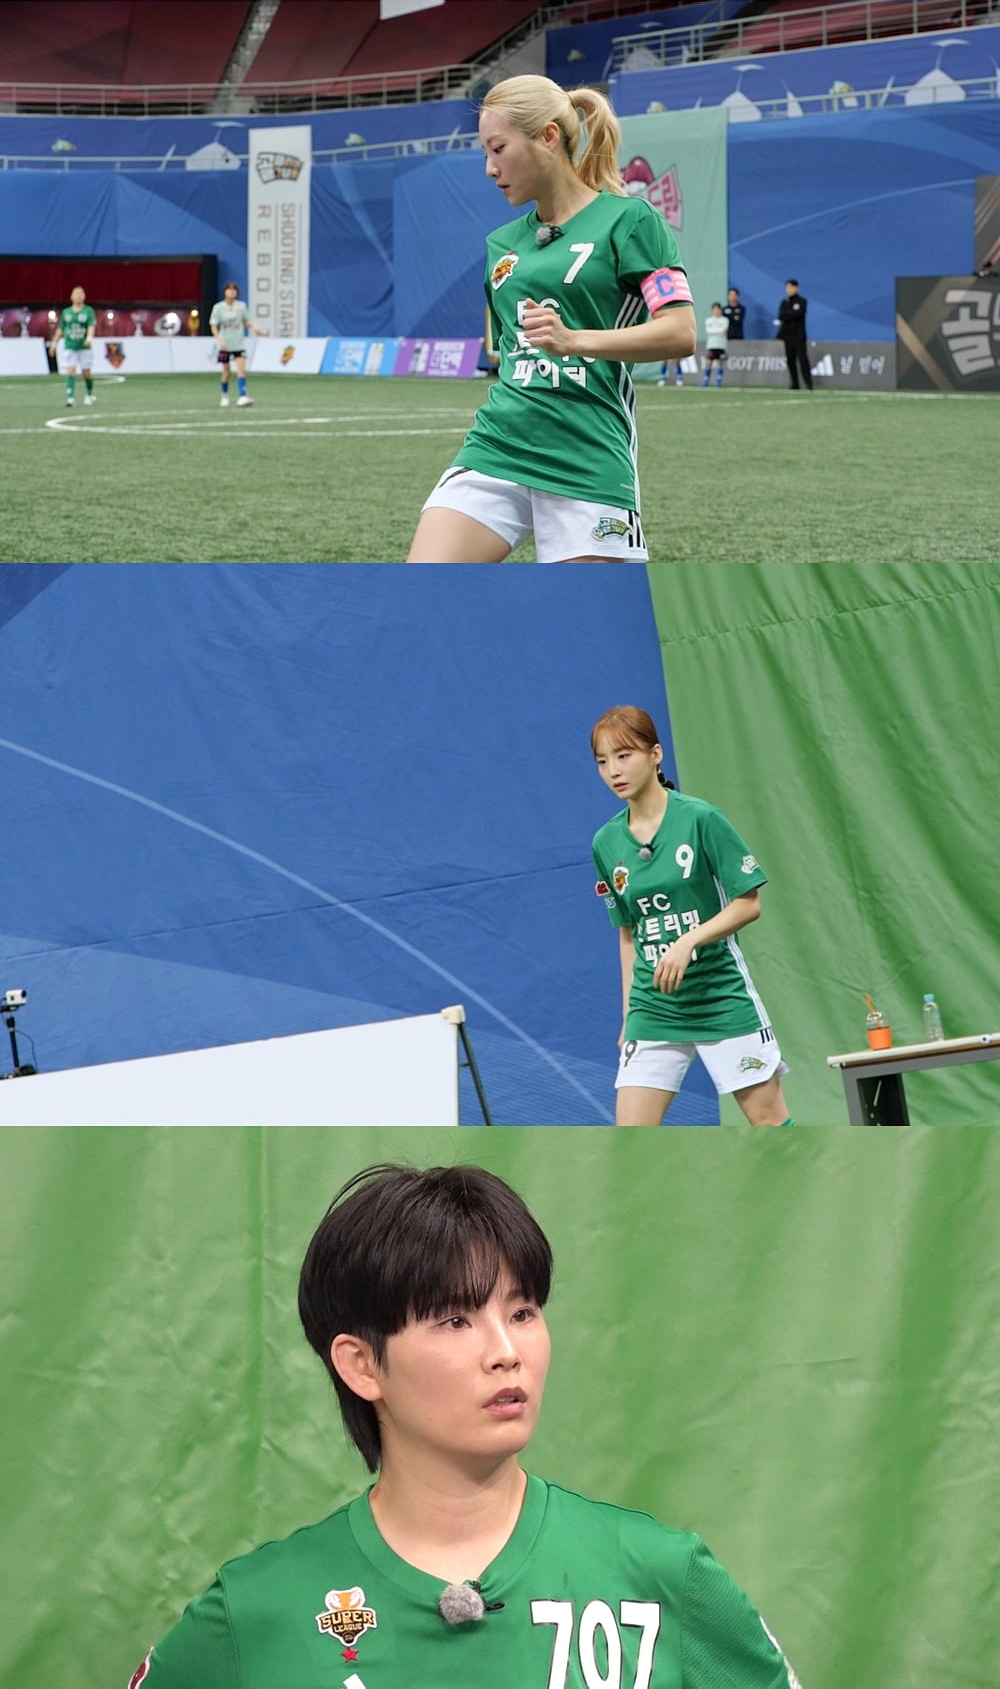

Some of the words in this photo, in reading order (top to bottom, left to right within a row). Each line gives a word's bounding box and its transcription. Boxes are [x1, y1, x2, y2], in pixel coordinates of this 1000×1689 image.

[280, 202, 297, 285] SHOOTING
[563, 242, 596, 285] 7
[655, 273, 676, 297] C
[675, 843, 695, 879] 9
[636, 893, 672, 916] FC
[637, 909, 701, 943] 트리밍
[624, 1040, 637, 1068] 9
[321, 1611, 373, 1629] SUPER
[333, 1623, 363, 1632] LEAGUE
[529, 1597, 661, 1689] 707
